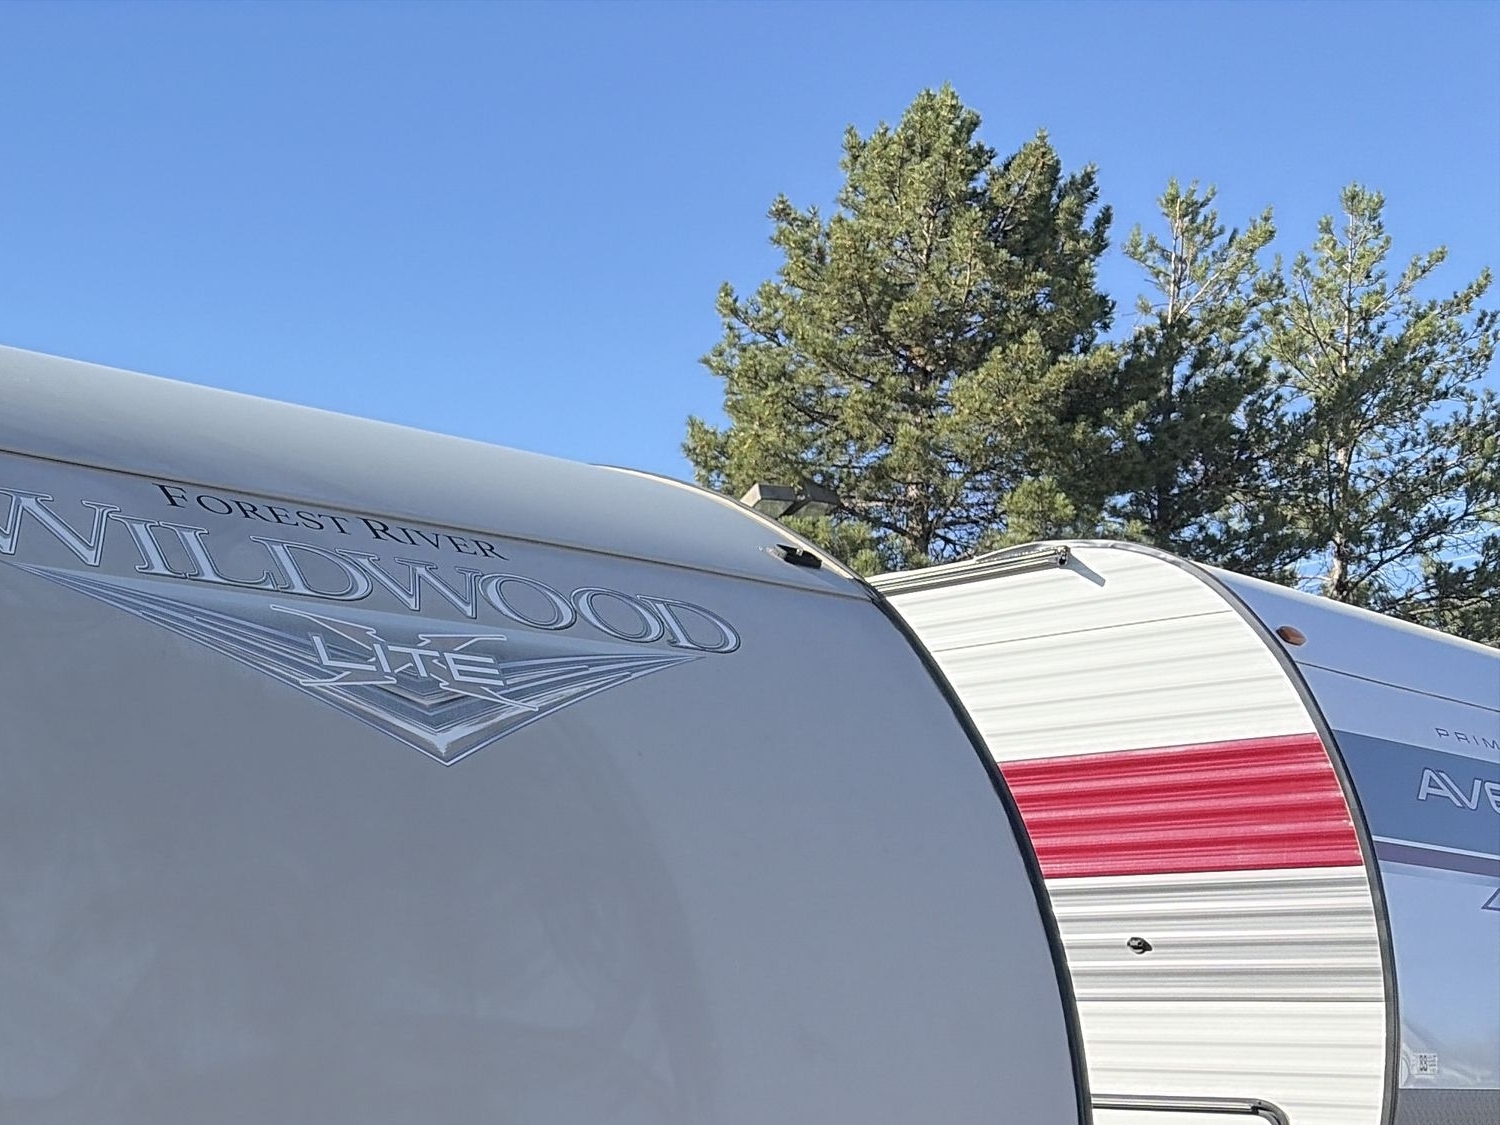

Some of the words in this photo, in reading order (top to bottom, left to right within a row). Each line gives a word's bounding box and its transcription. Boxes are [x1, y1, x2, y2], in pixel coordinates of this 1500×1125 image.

[152, 483, 350, 535] FOREST
[356, 516, 509, 561] RIVER
[311, 635, 505, 687] LITE
